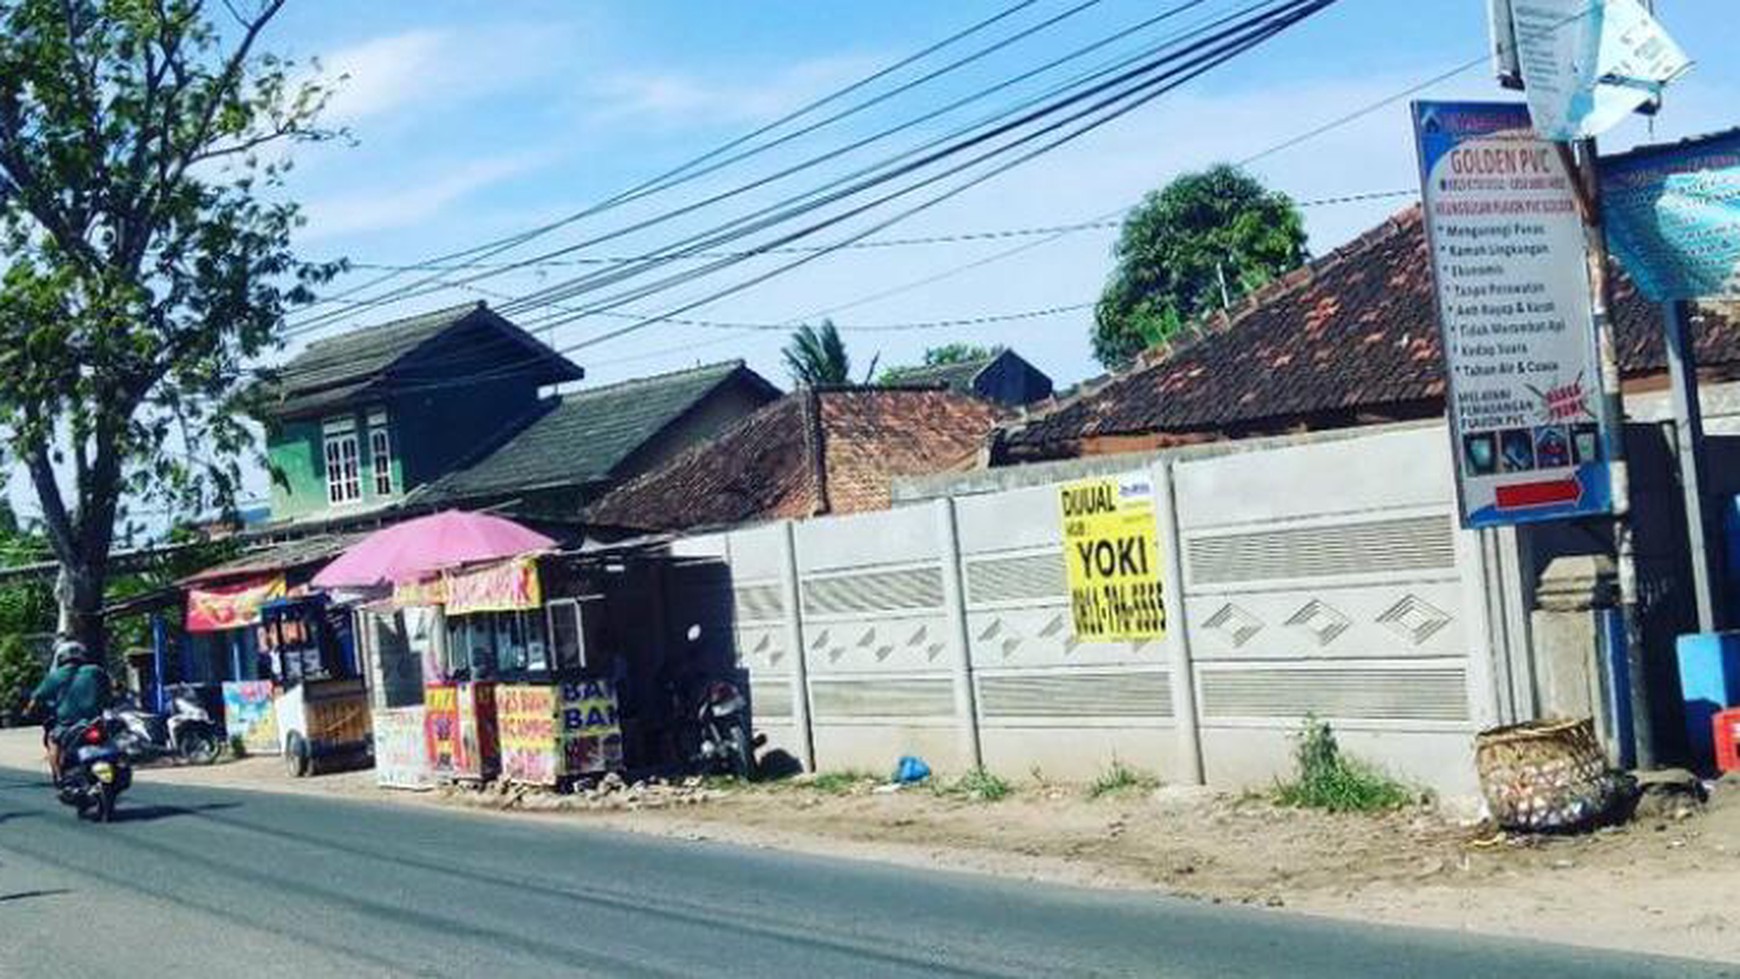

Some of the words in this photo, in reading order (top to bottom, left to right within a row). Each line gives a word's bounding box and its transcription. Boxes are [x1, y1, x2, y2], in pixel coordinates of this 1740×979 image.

[1450, 148, 1517, 174] GOLDEN
[1519, 148, 1551, 174] PVC
[1516, 301, 1525, 314] &
[1516, 360, 1526, 374] &
[1077, 535, 1149, 580] YOKI
